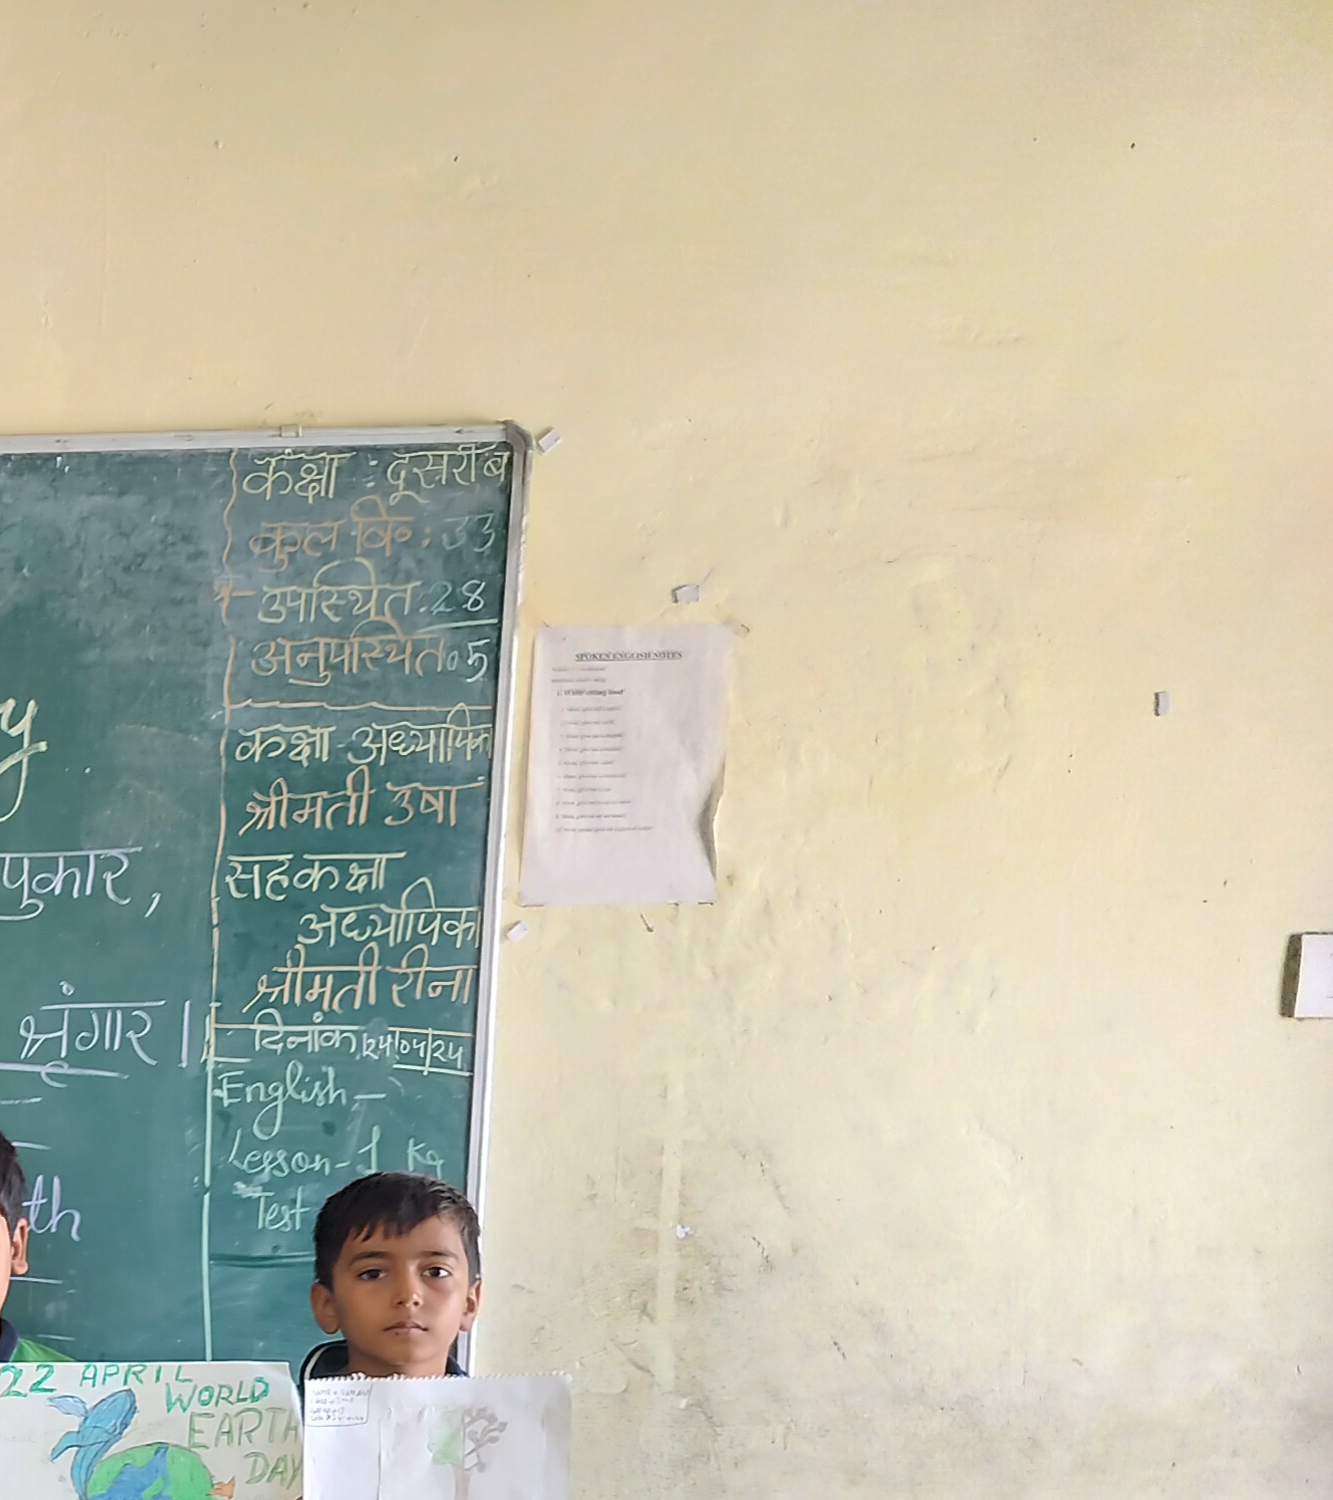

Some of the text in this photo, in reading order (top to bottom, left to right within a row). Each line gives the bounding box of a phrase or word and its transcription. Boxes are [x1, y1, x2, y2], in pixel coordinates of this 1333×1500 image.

[237, 764, 377, 837] श्रीमती
[241, 942, 479, 1014] श्रीमती रीना
[241, 1184, 312, 1233] Test
[79, 1362, 194, 1389] APRIL
[164, 1376, 271, 1414] WORLD
[188, 1407, 302, 1450] EARTH
[244, 1451, 304, 1490] DAY
